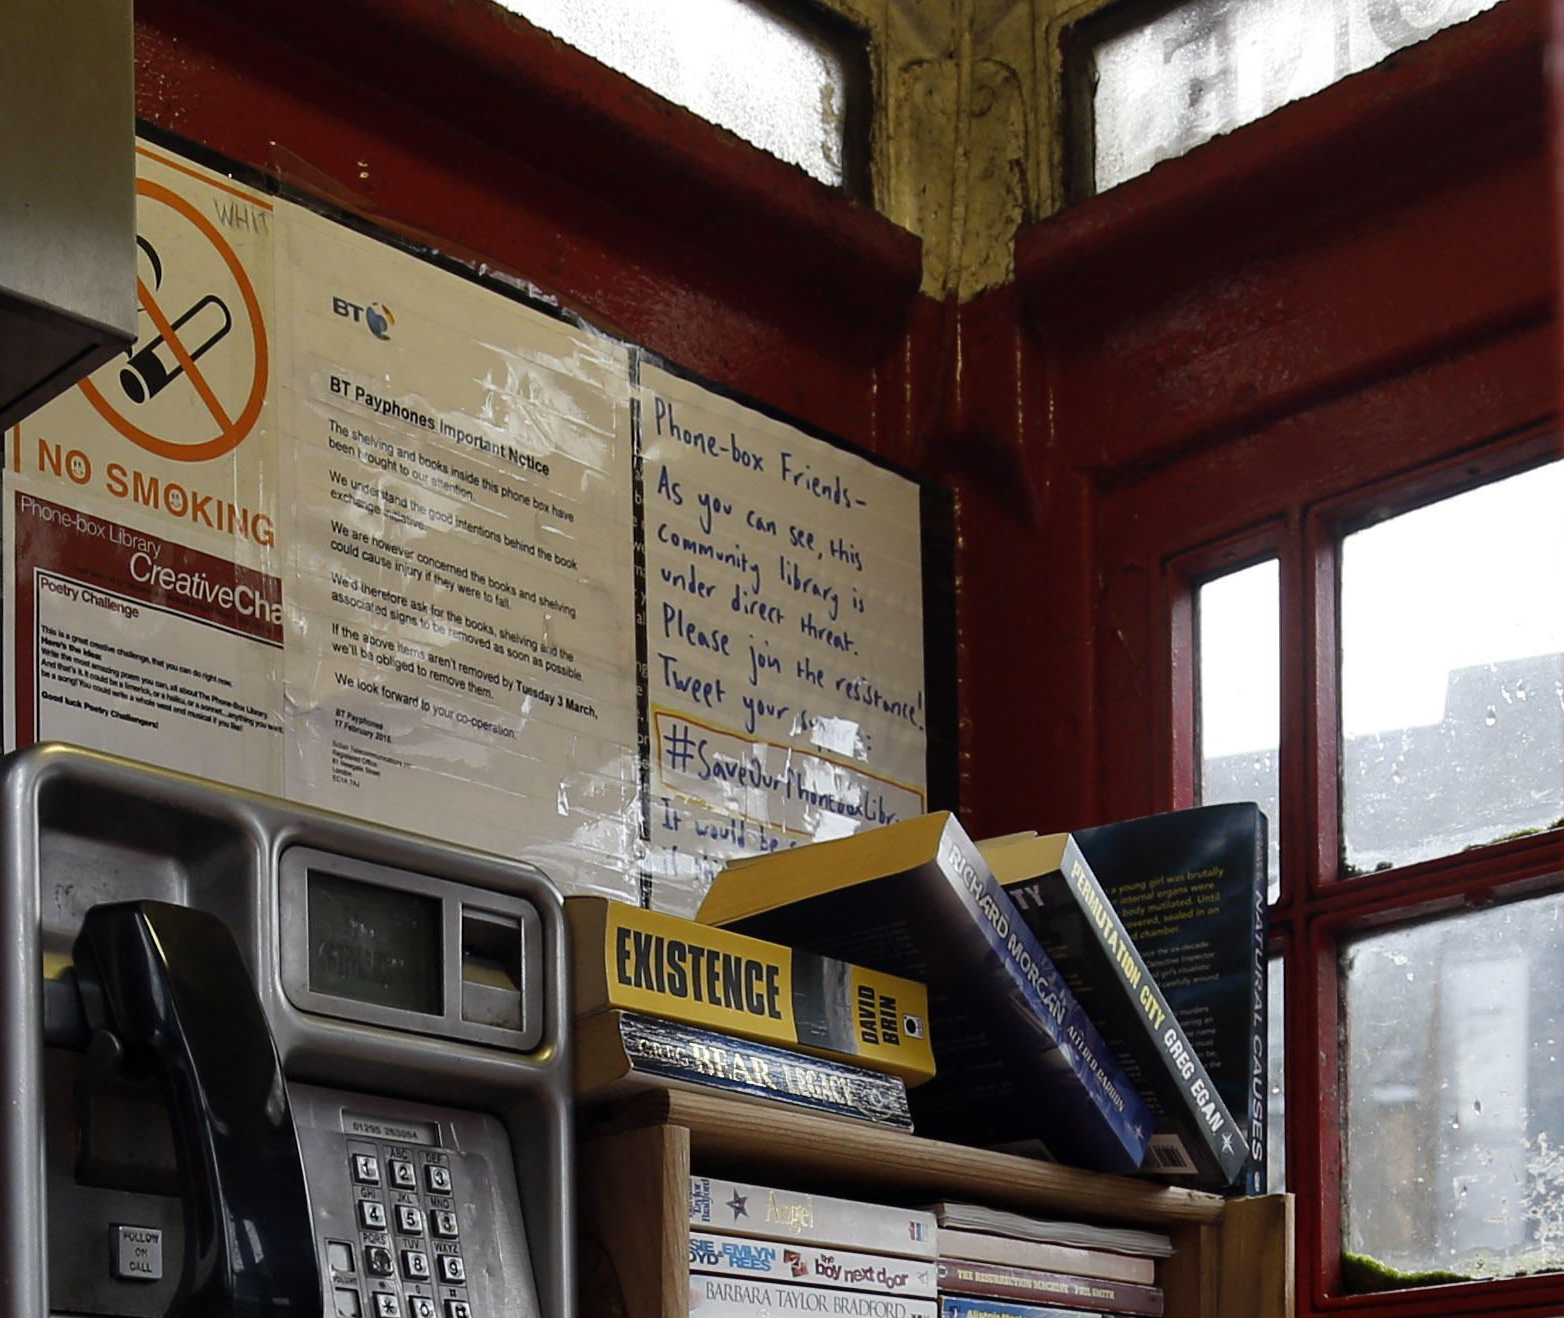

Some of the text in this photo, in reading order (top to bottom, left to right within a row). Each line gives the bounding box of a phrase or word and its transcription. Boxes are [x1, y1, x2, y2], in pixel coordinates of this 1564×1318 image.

[332, 296, 364, 325] BT
[330, 376, 550, 476] BT Payphones Important Notice
[655, 397, 764, 472] Phone-box
[38, 439, 276, 547] NO SMOKING
[329, 419, 574, 523] The shelving and books inside this phone have
[21, 495, 161, 558] Phone-box Library
[657, 465, 862, 571] As you can see, this
[40, 577, 140, 618] Poetry Challenge
[658, 523, 864, 621] community library is
[660, 565, 859, 655] under direct threat.
[663, 602, 730, 656] Please
[749, 635, 781, 685] join
[797, 658, 824, 688] the
[342, 626, 598, 719] the aren't removed Tuesday March,
[658, 653, 788, 733] Tweet your
[947, 844, 1069, 1025] RICHARD MORGAN
[615, 926, 781, 1020] EXISTENCE
[1071, 859, 1142, 988] PERMUTATION
[1138, 985, 1165, 1030] CITY
[1163, 1027, 1195, 1080] GREG
[1189, 1076, 1225, 1134] EGAN
[857, 984, 879, 1045] DAVID
[879, 994, 900, 1046] BRIN
[1251, 889, 1264, 1162] NATURAL CAUSES
[689, 1043, 776, 1089] BEAR
[1066, 1025, 1101, 1075] ALTERED
[426, 1153, 443, 1163] DEF
[361, 1188, 450, 1209] GHI MNO
[766, 1191, 814, 1234] Angel
[123, 1232, 159, 1243] FOLLOW
[135, 1247, 147, 1257] ON
[363, 1233, 387, 1245] PQRS
[722, 1243, 776, 1260] EMLYN
[821, 1254, 834, 1264] the
[129, 1262, 152, 1273] CALL
[729, 1257, 772, 1271] REES
[815, 1259, 908, 1289] boy next door
[706, 1281, 772, 1306] BARBARA
[776, 1290, 828, 1312] TAYLOR
